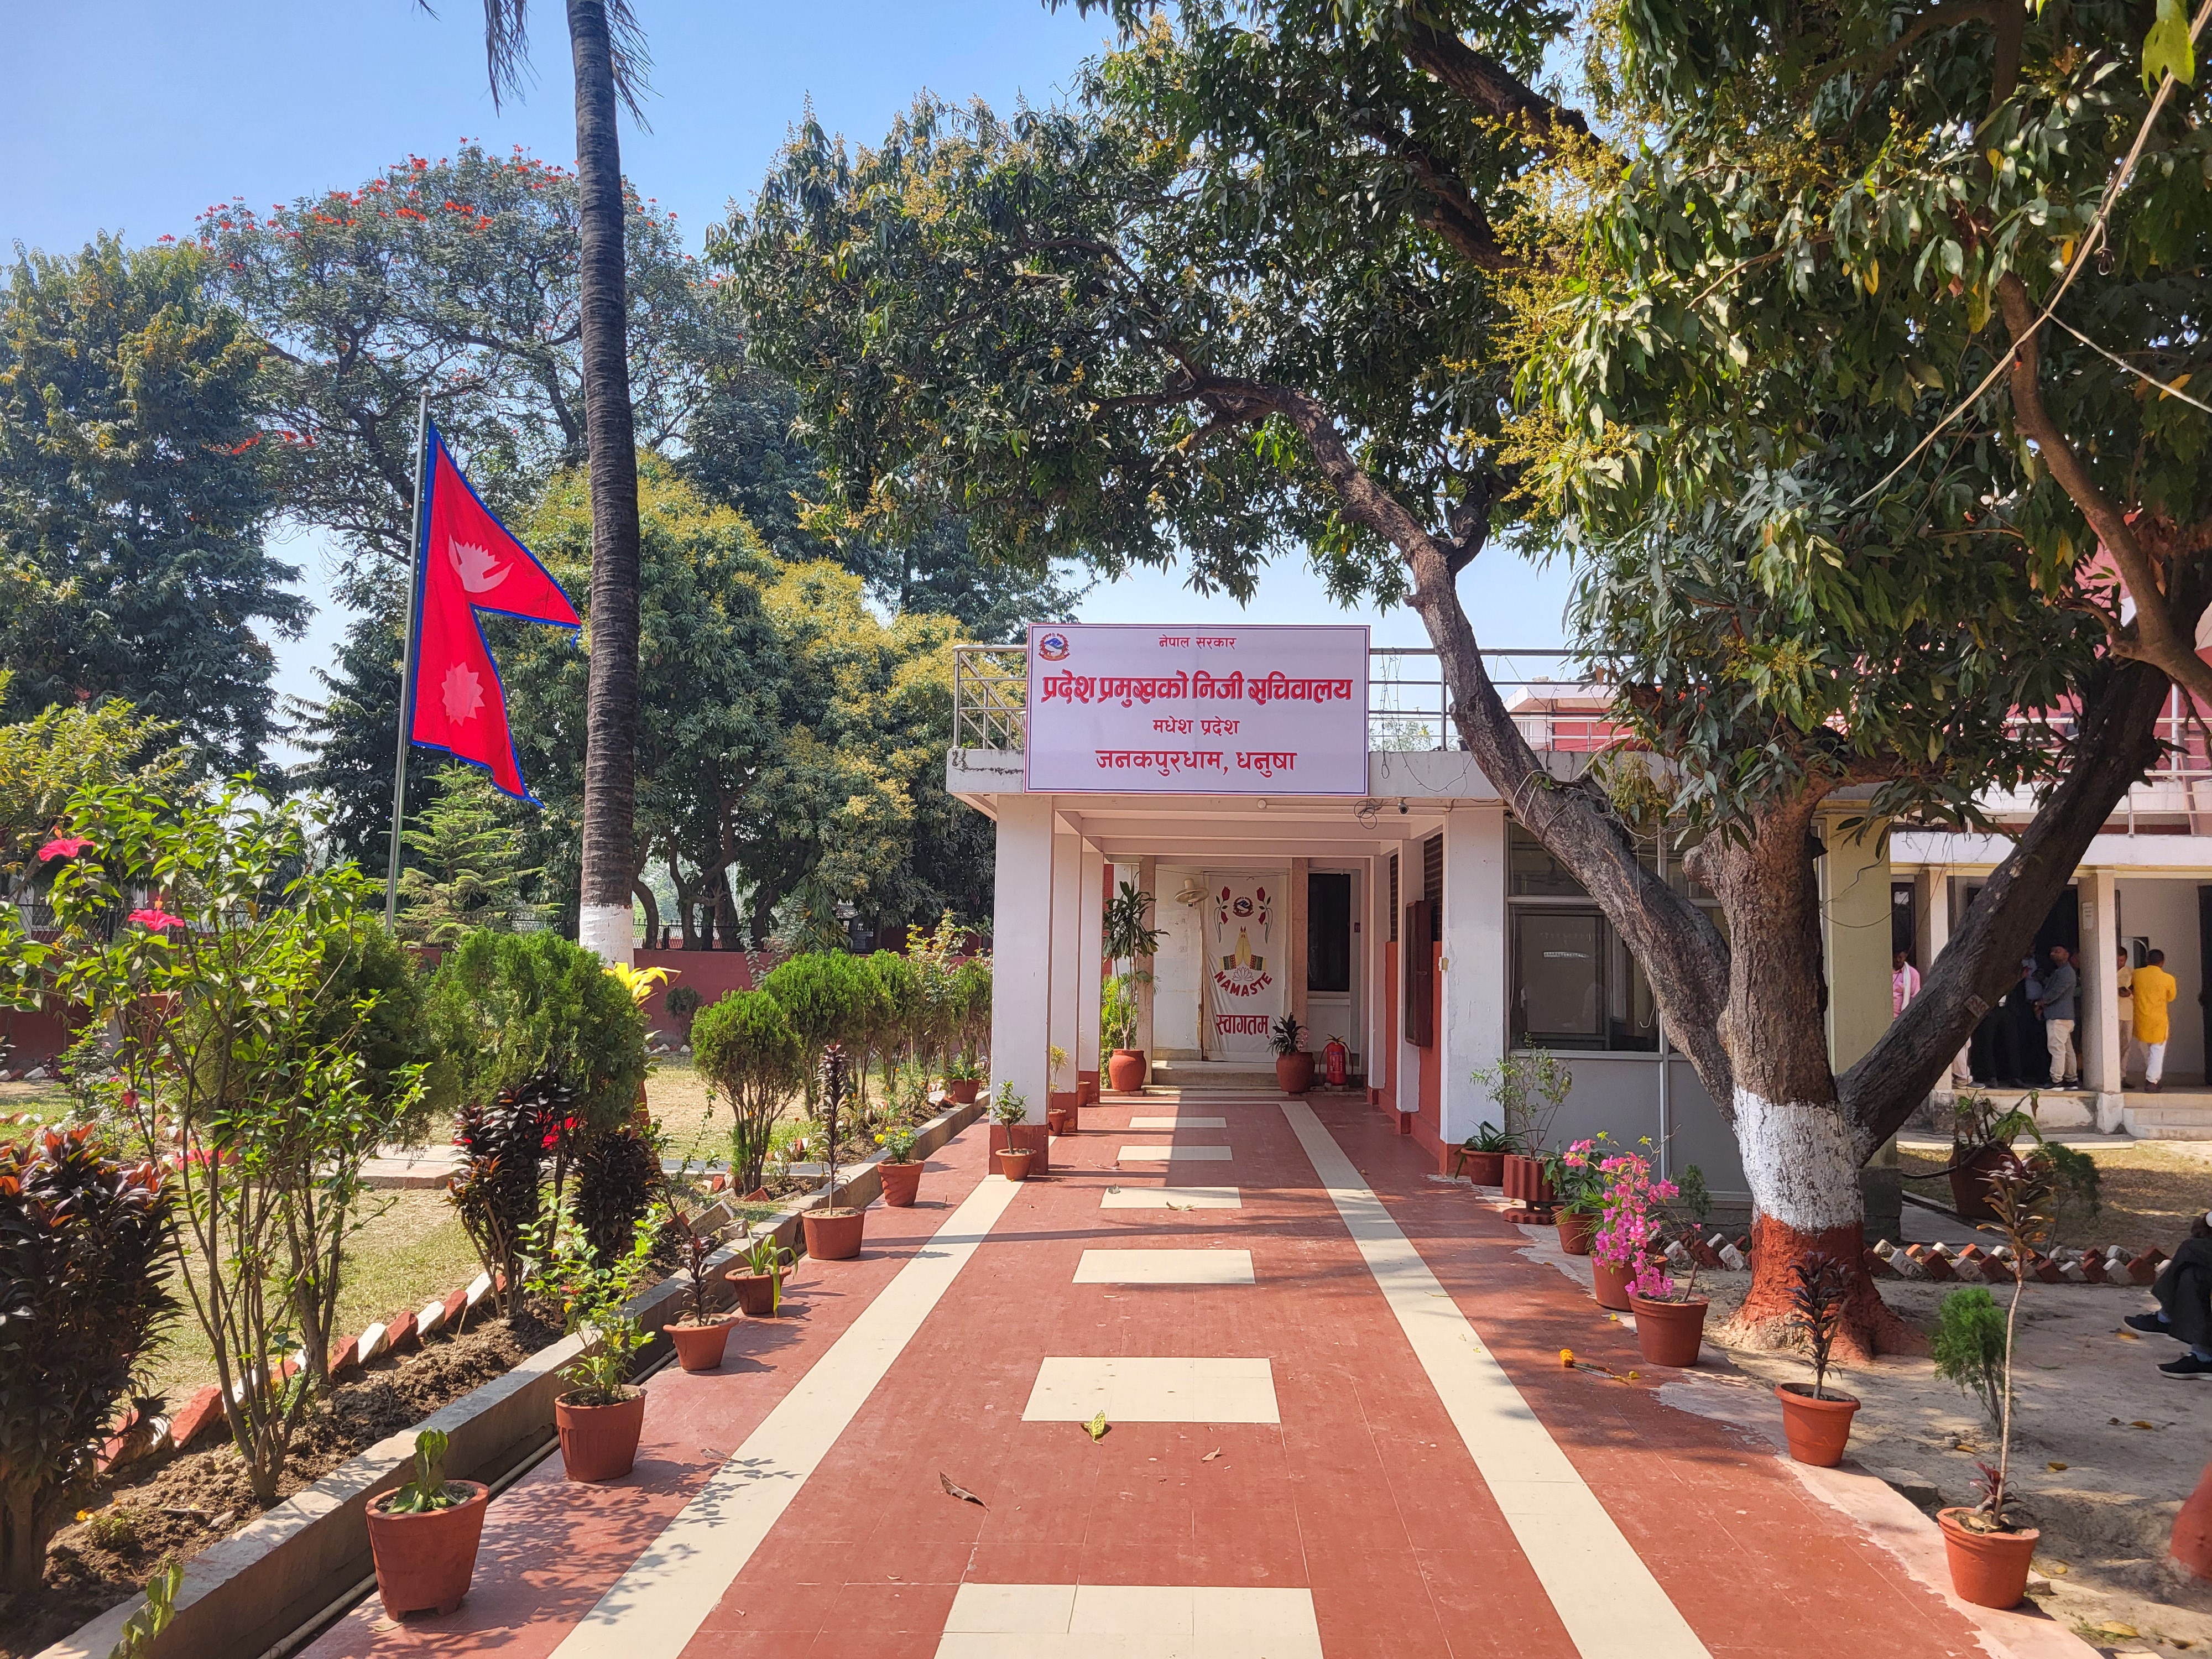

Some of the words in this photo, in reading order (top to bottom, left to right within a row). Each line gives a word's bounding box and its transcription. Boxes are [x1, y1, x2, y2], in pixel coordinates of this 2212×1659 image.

[1159, 635, 1190, 648] नेपाल
[1196, 637, 1237, 649] सरकार
[1041, 669, 1097, 704] प्रदेश
[1097, 670, 1189, 708] प्रमुखको
[1192, 670, 1244, 700] निजी
[1247, 671, 1353, 706] सचिवालय
[1153, 716, 1193, 734] मधेश
[1201, 716, 1240, 736] प्रदेश
[1095, 750, 1229, 777] जनकपुरधाम,
[1236, 751, 1297, 779] धनुषा
[1214, 971, 1272, 997] NAMASTE
[1216, 1014, 1270, 1039] स्वागतम्
